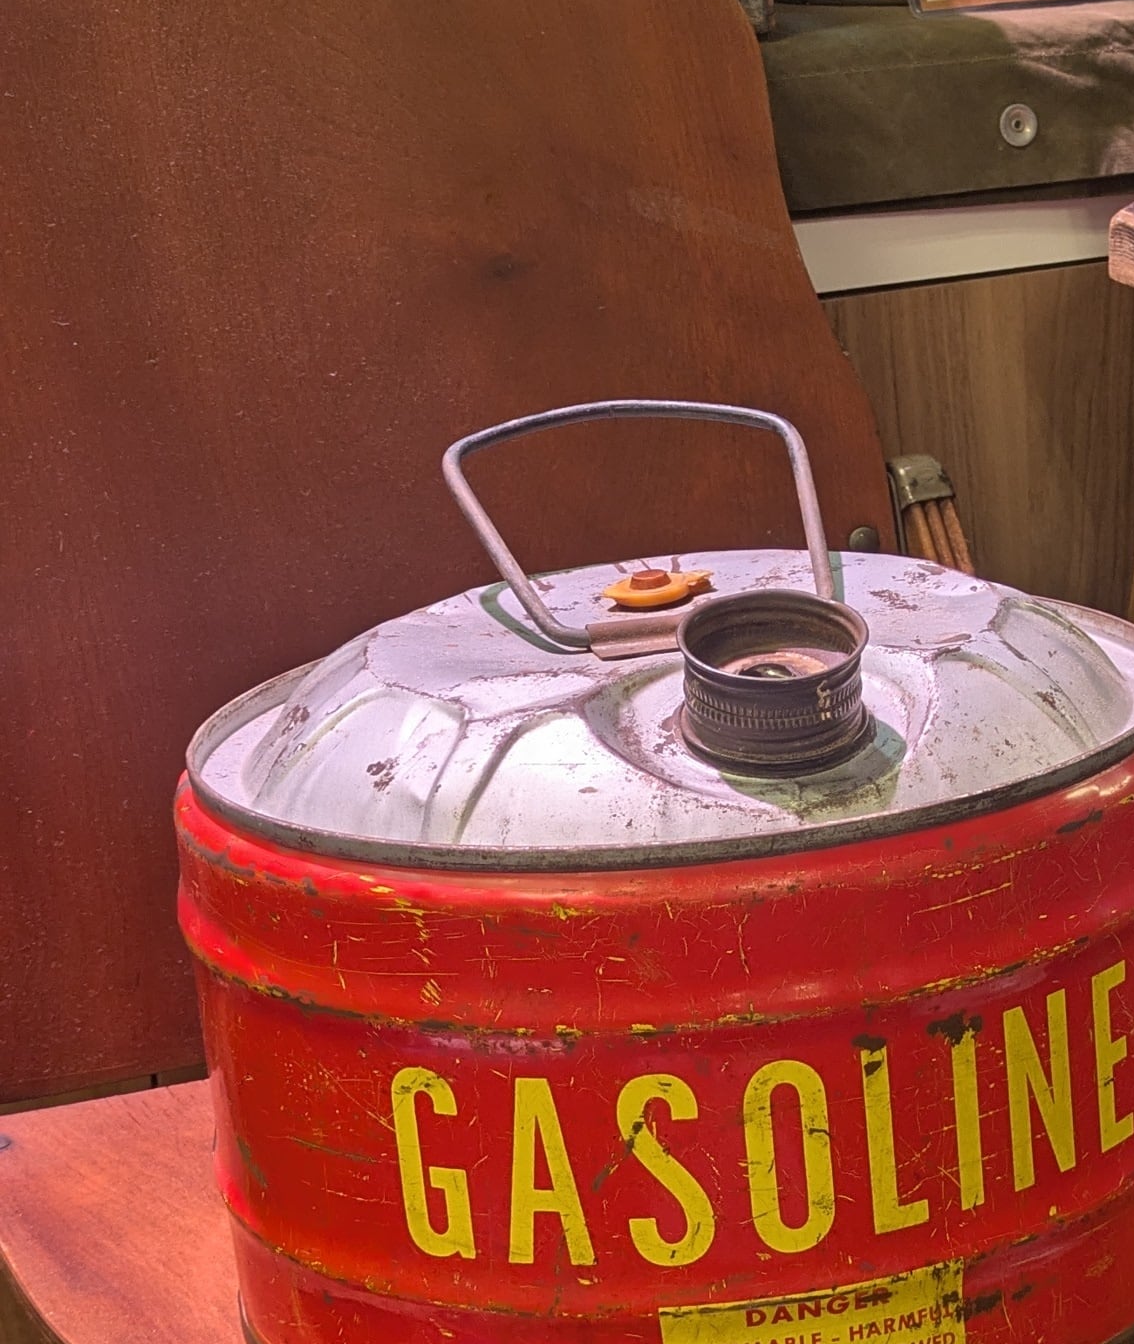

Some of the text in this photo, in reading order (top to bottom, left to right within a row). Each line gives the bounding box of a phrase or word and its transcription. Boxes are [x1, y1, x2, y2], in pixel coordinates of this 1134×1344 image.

[392, 960, 1134, 1267] GASOLINE
[746, 1287, 892, 1328] DANGER
[850, 1304, 955, 1343] HARMFUL
